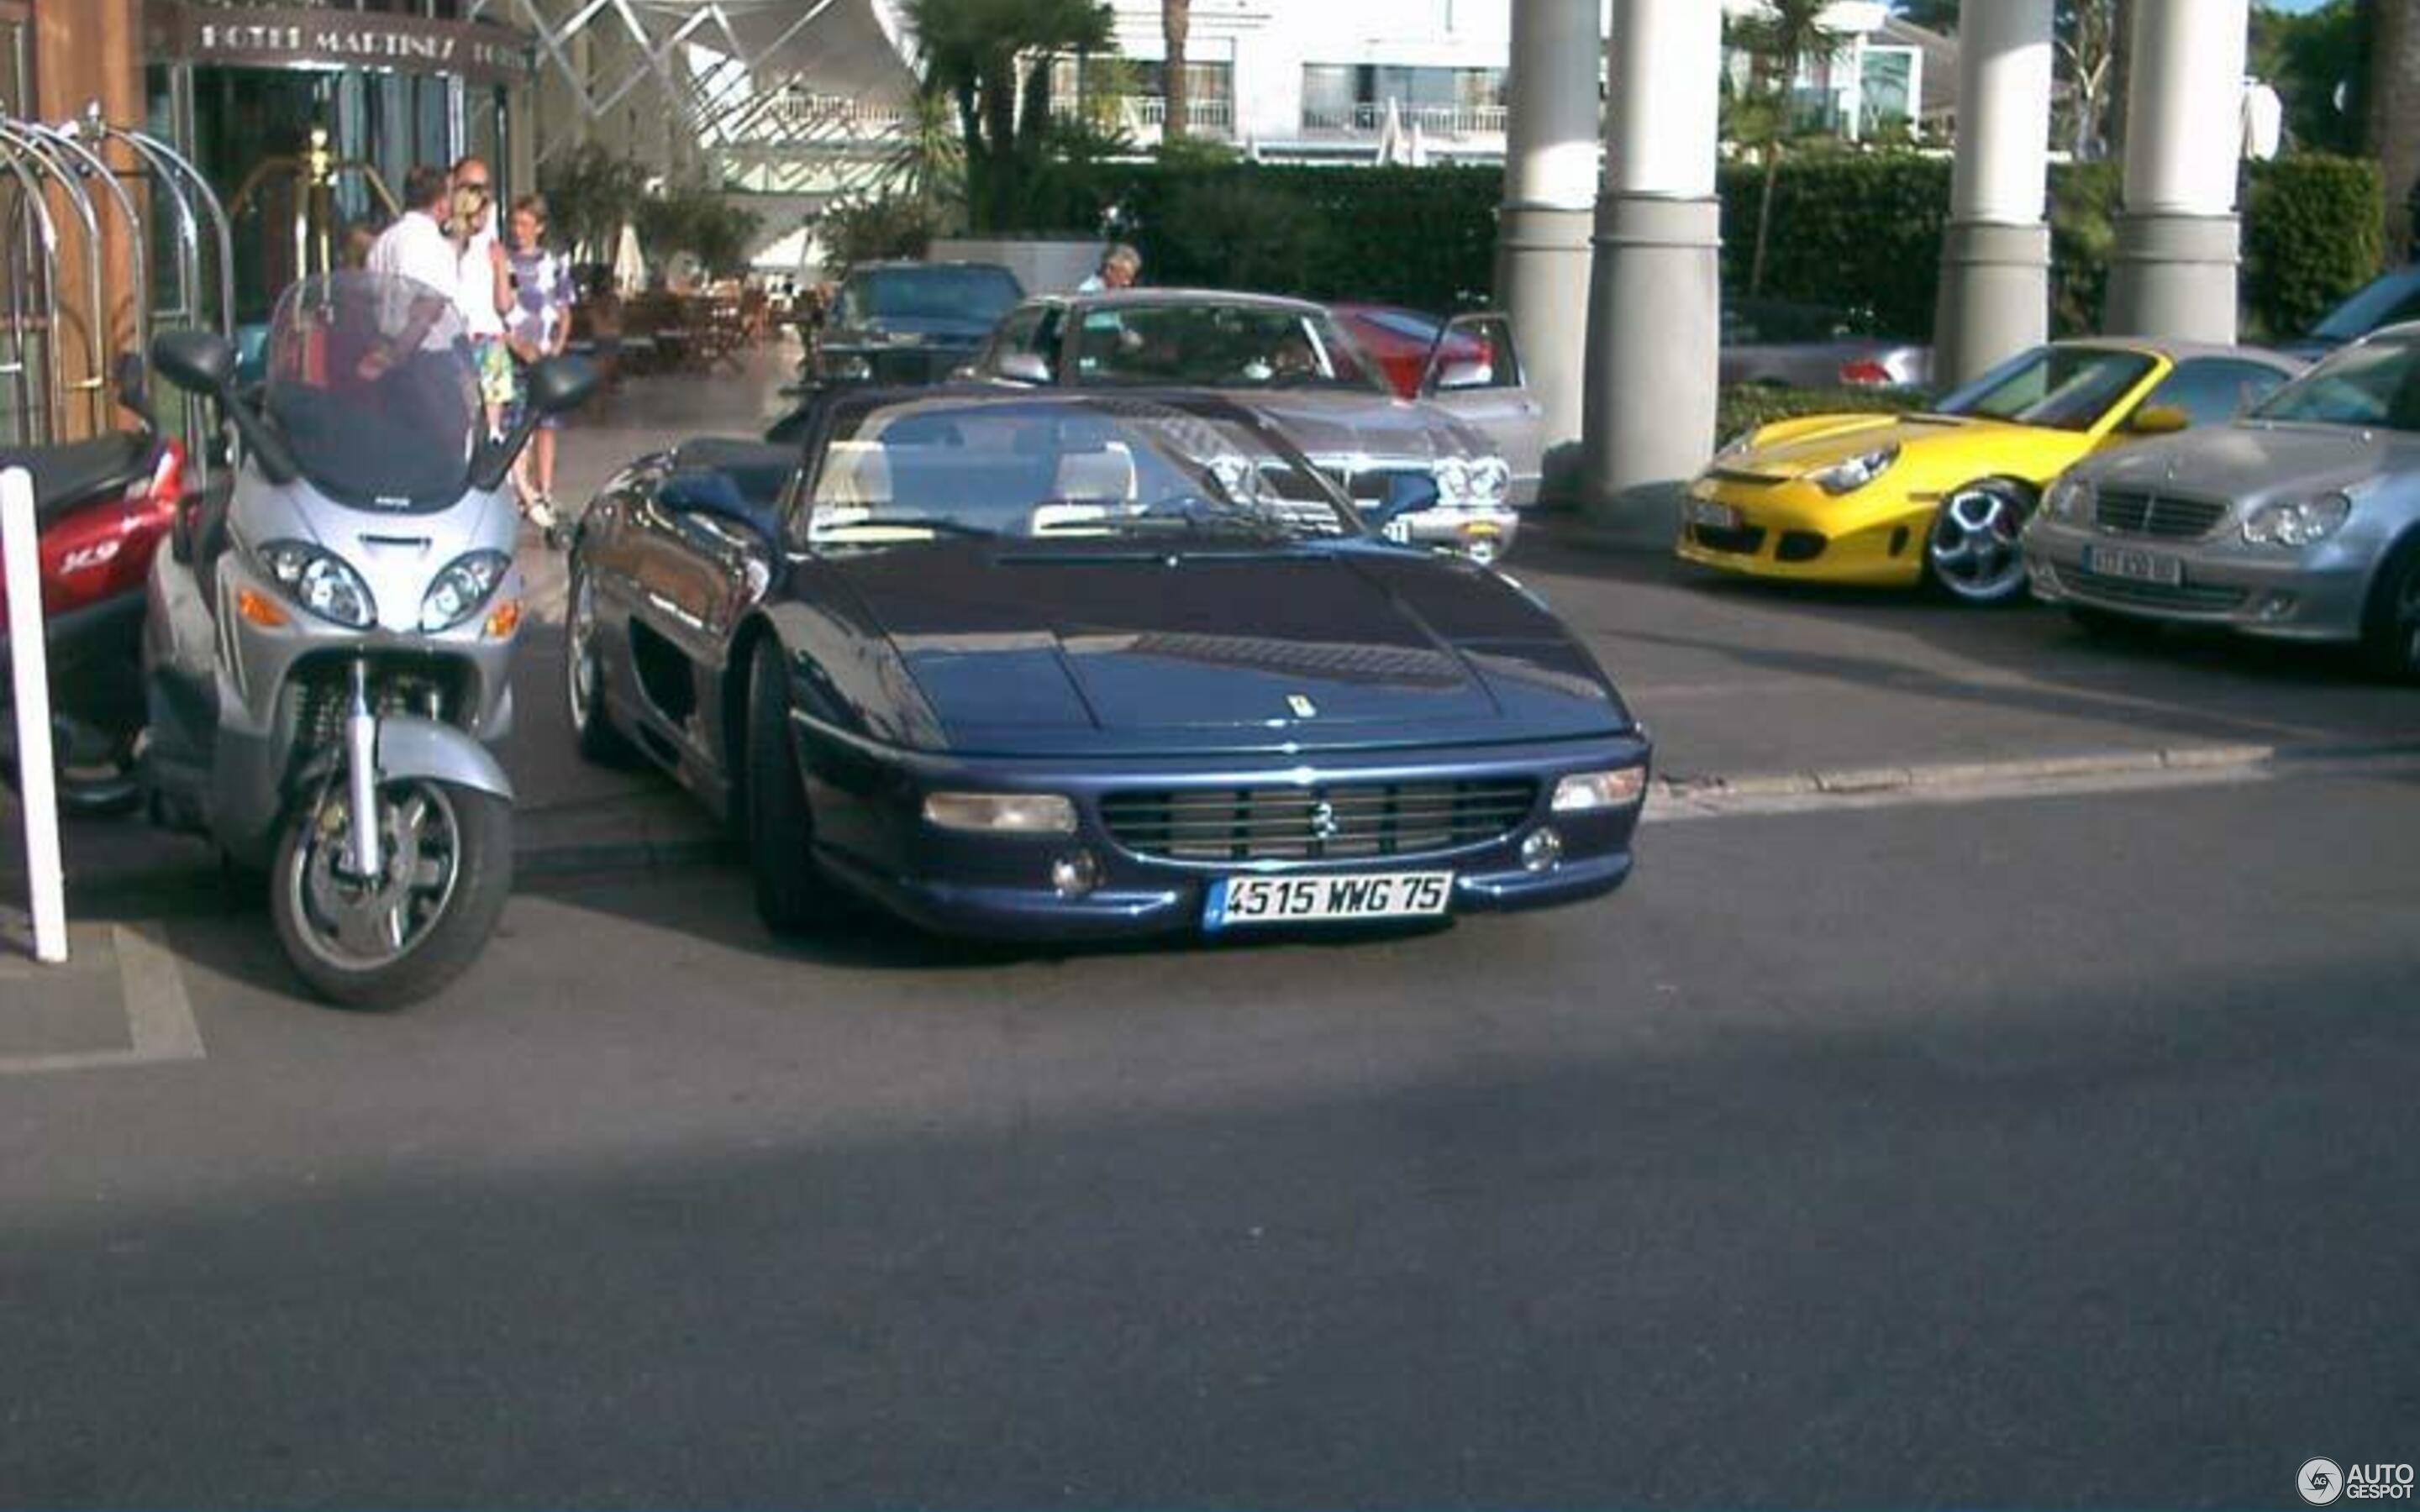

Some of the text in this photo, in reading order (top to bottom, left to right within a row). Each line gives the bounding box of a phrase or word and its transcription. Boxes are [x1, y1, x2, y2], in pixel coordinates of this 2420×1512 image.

[1228, 877, 1445, 915] 4515 WWG 75
